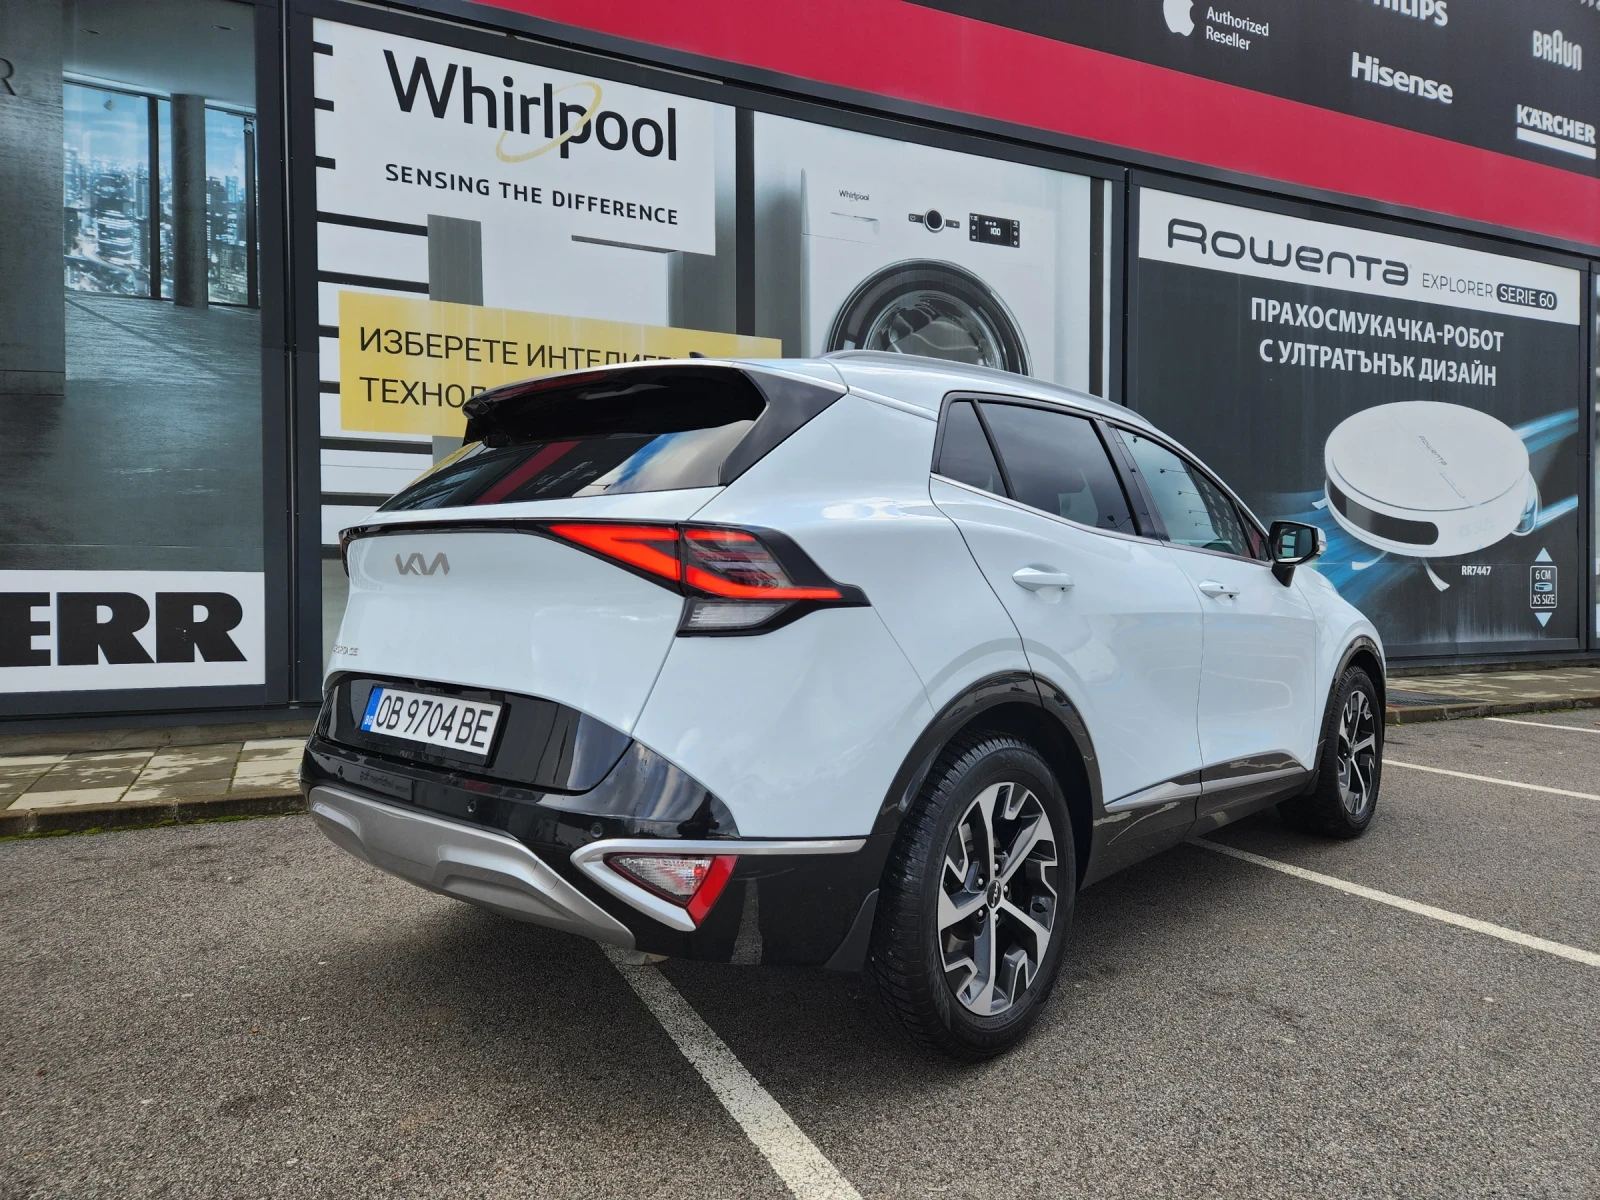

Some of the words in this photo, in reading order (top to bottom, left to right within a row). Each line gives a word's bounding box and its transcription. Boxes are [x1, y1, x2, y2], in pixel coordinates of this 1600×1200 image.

[1206, 6, 1269, 36] Authorized
[1206, 25, 1251, 50] Reseller
[1351, 51, 1454, 104] Hisense
[383, 49, 677, 161] Whirlpool
[1516, 104, 1596, 144] KÄRCHER
[385, 163, 490, 196] SENSING
[498, 181, 542, 205] THE
[552, 190, 678, 225] DIFFERENCE
[838, 189, 870, 202] Whirlpool
[1421, 272, 1493, 298] EXPLORER
[1499, 285, 1537, 306] SERIE
[1540, 292, 1555, 308] 60
[1251, 297, 1505, 352] ПРАХОСМУКАЧКА-РОБОТ
[360, 326, 518, 365] ИЗБЕРЕТЕ
[1259, 339, 1273, 362] С
[1277, 340, 1416, 378] УЛТРАТЪНЪК
[1418, 358, 1497, 386] ДИЗАЙН
[1461, 565, 1491, 576] RR7447
[1535, 570, 1540, 580] 6
[1541, 570, 1551, 580] CM
[1532, 594, 1541, 605] XS
[1542, 594, 1555, 605] SIZE
[364, 715, 374, 726] BG
[376, 695, 404, 730] OB
[404, 699, 458, 741] 9704
[455, 707, 494, 748] BE
